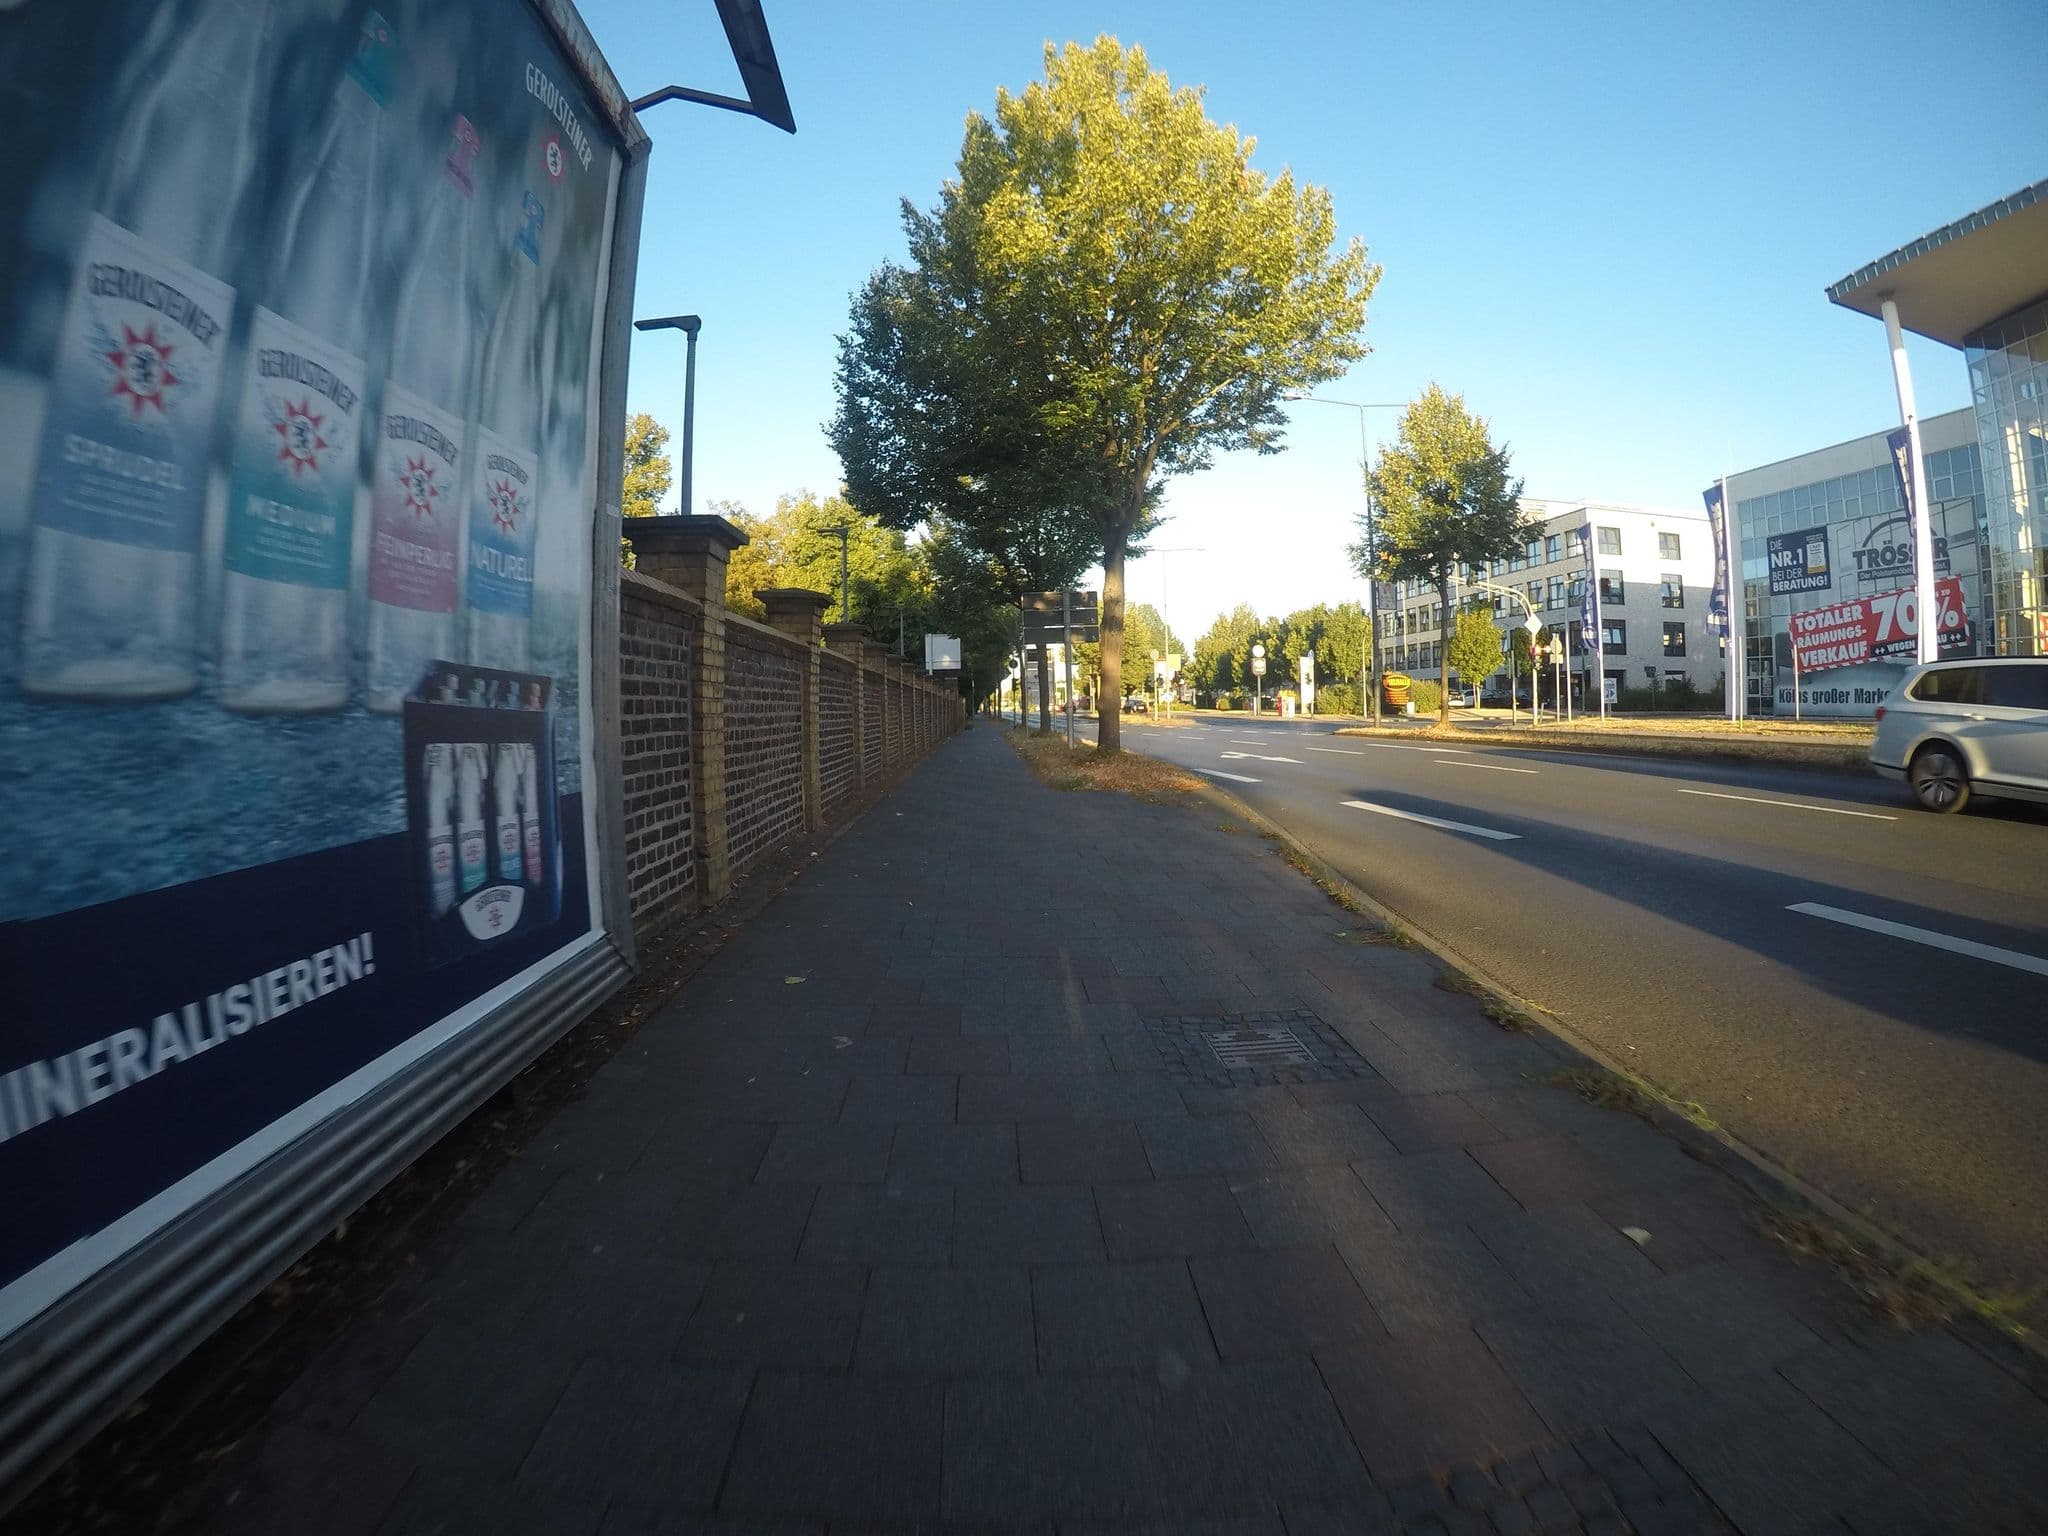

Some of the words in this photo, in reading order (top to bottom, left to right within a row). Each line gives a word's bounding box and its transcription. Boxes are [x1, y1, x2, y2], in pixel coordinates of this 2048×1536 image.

[525, 62, 592, 172] GEROLSTEINER
[1770, 539, 1783, 551] DIE
[1852, 537, 1949, 570] TRÖSR
[1770, 548, 1804, 569] NR.1
[1772, 570, 1785, 582] BEI
[1786, 567, 1803, 580] DER
[1773, 574, 1828, 592] BERATUNG!
[1796, 604, 1864, 633] TOTALER
[1797, 625, 1867, 649] RÄUMUNGS-
[1887, 640, 1916, 653] WEGEN
[1800, 641, 1868, 668] VERKAUF
[1812, 688, 1850, 705] großer
[0, 931, 377, 1145] INERALISIEREN!
